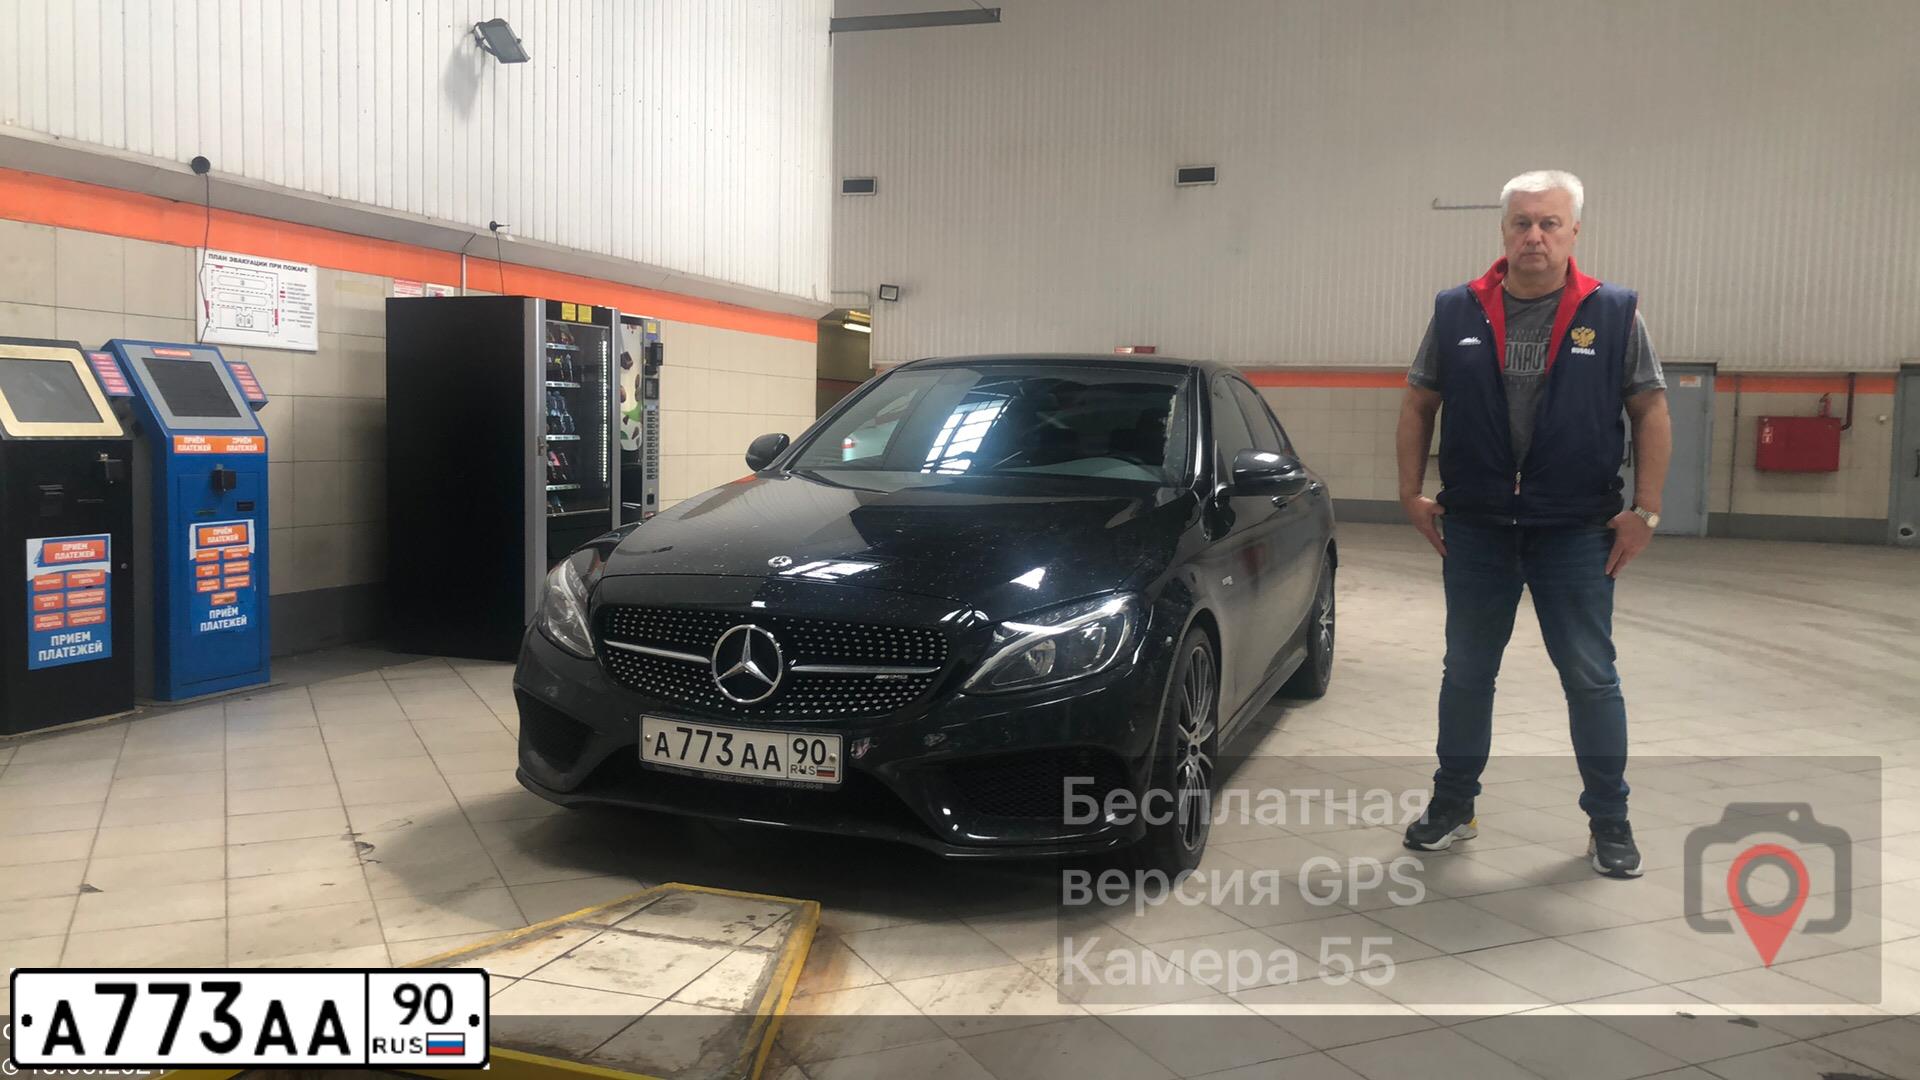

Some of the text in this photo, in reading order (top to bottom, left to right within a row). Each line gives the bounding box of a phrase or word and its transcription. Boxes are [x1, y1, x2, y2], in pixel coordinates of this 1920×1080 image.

[208, 253, 227, 261] ПЛАН
[229, 256, 268, 267] ЭВАКУАЦИИ
[283, 264, 308, 273] ПОЖАРЕ
[1571, 346, 1596, 355] RUSSIA
[54, 549, 96, 560] ПЛАТЕЖЕЙ
[209, 605, 239, 619] ПРИЁМ
[200, 615, 247, 632] ПЛАТЕЖЕЙ
[51, 631, 91, 646] ПРИЕМ
[38, 640, 103, 661] ПЛАТЕЖЕЙ
[792, 738, 826, 765] 90
[790, 764, 816, 775] RUS
